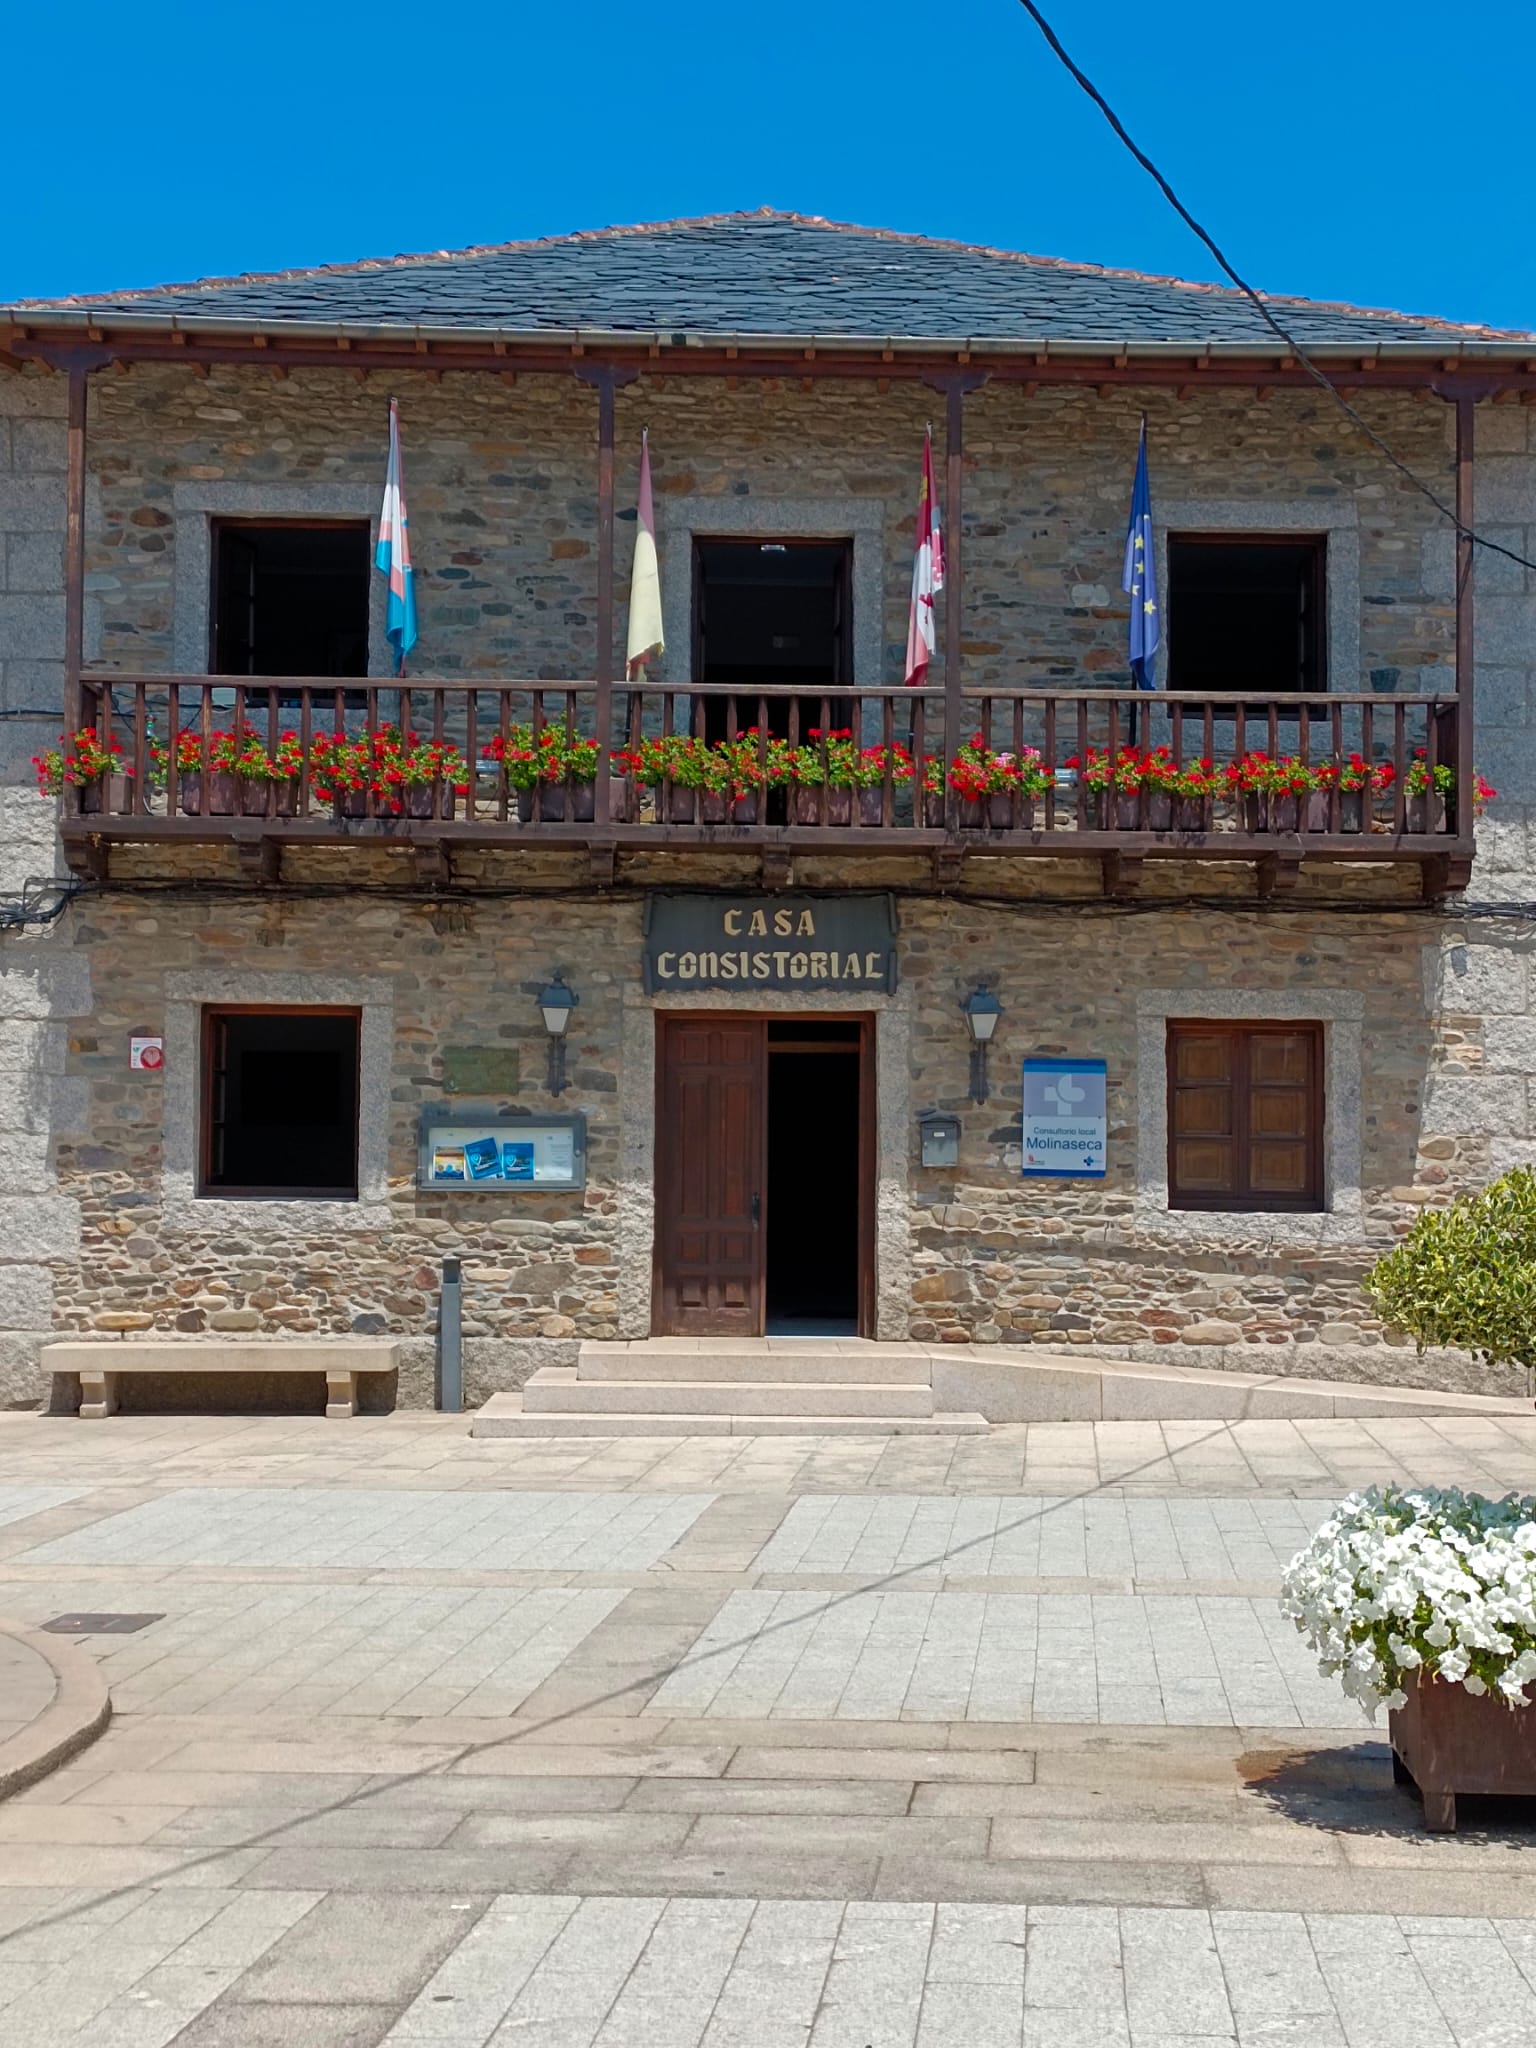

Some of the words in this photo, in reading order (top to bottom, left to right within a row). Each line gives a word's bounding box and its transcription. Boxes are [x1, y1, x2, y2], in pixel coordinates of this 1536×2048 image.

[723, 908, 816, 936] CASA
[657, 951, 885, 979] CONSISTORIAL
[1033, 1126, 1077, 1136] Consultorio
[1078, 1127, 1096, 1136] local
[1026, 1137, 1103, 1151] Molinaseca
